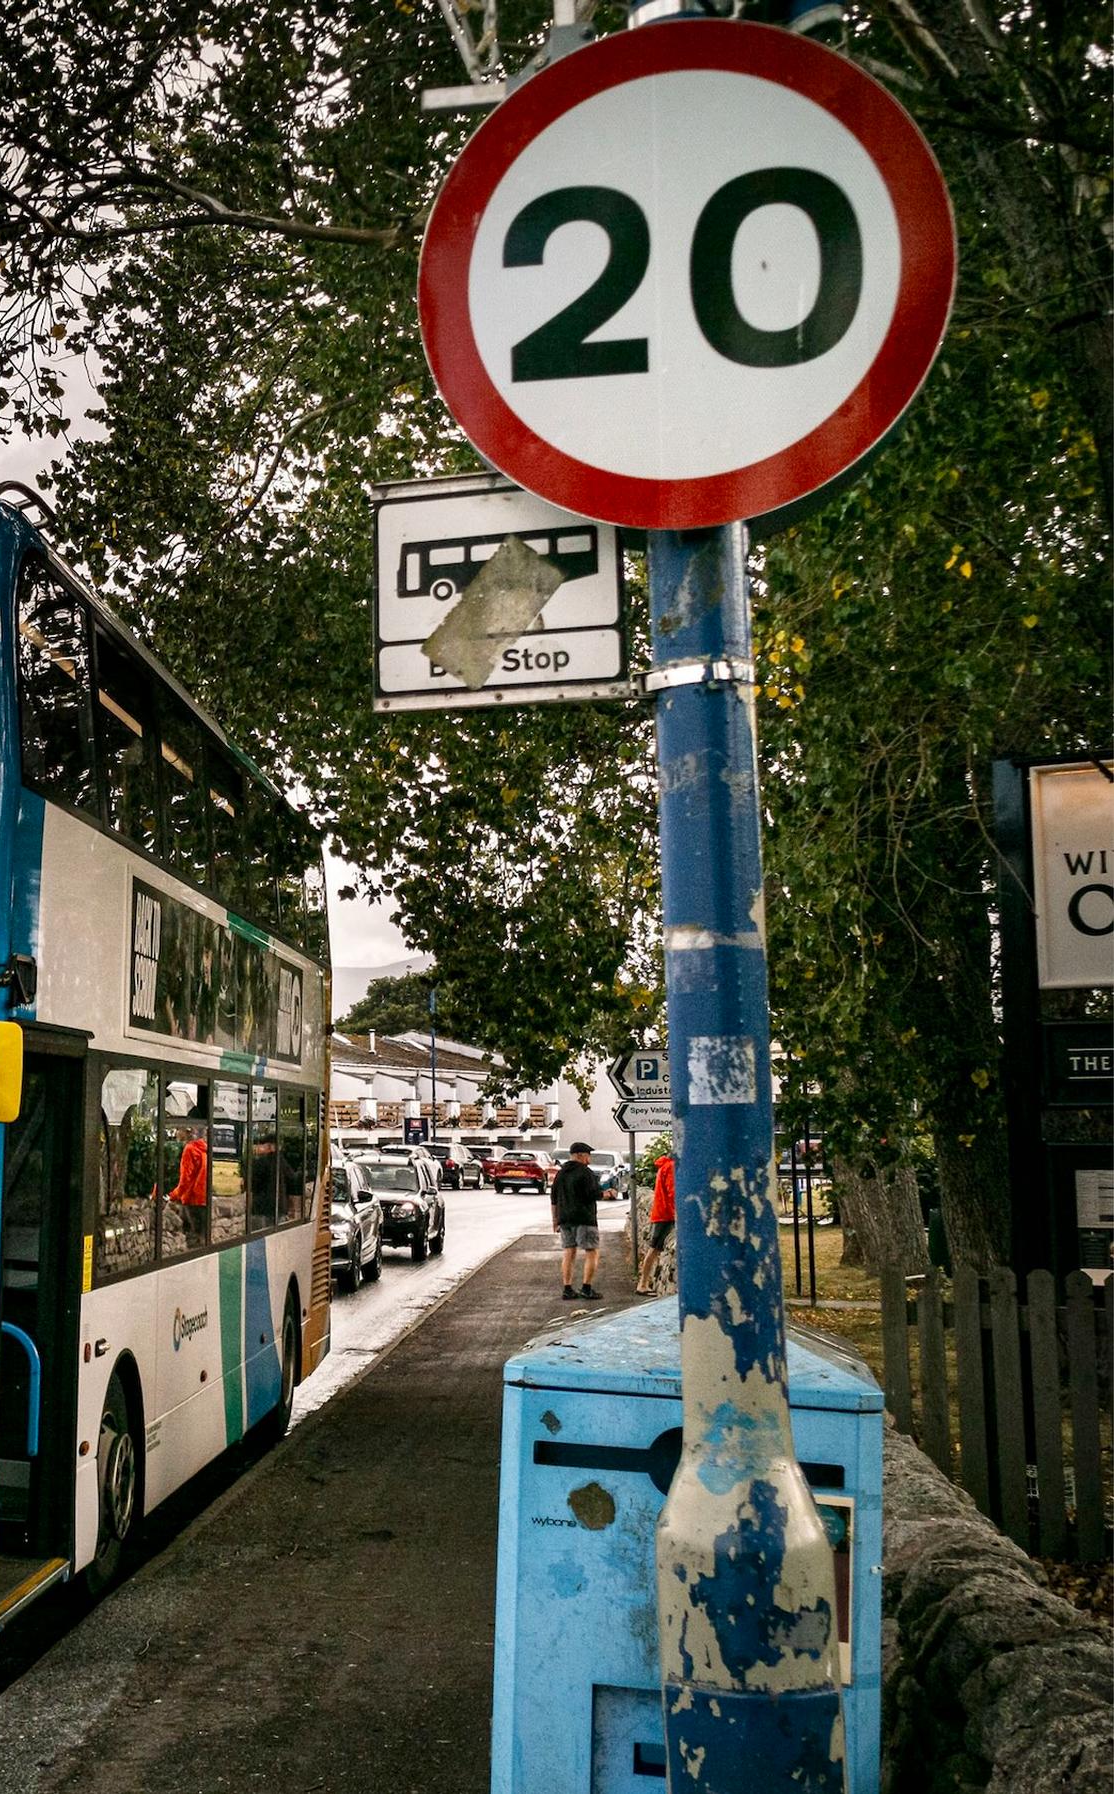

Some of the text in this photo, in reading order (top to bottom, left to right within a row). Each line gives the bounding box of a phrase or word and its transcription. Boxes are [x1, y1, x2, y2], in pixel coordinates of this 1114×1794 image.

[503, 166, 863, 383] 20
[502, 648, 570, 672] Stop
[1063, 850, 1114, 875] WI
[1068, 884, 1114, 936] O
[1069, 1056, 1111, 1071] THE
[636, 1086, 671, 1096] Indust
[630, 1107, 648, 1115] Spey
[181, 1304, 208, 1341] Stagecoach
